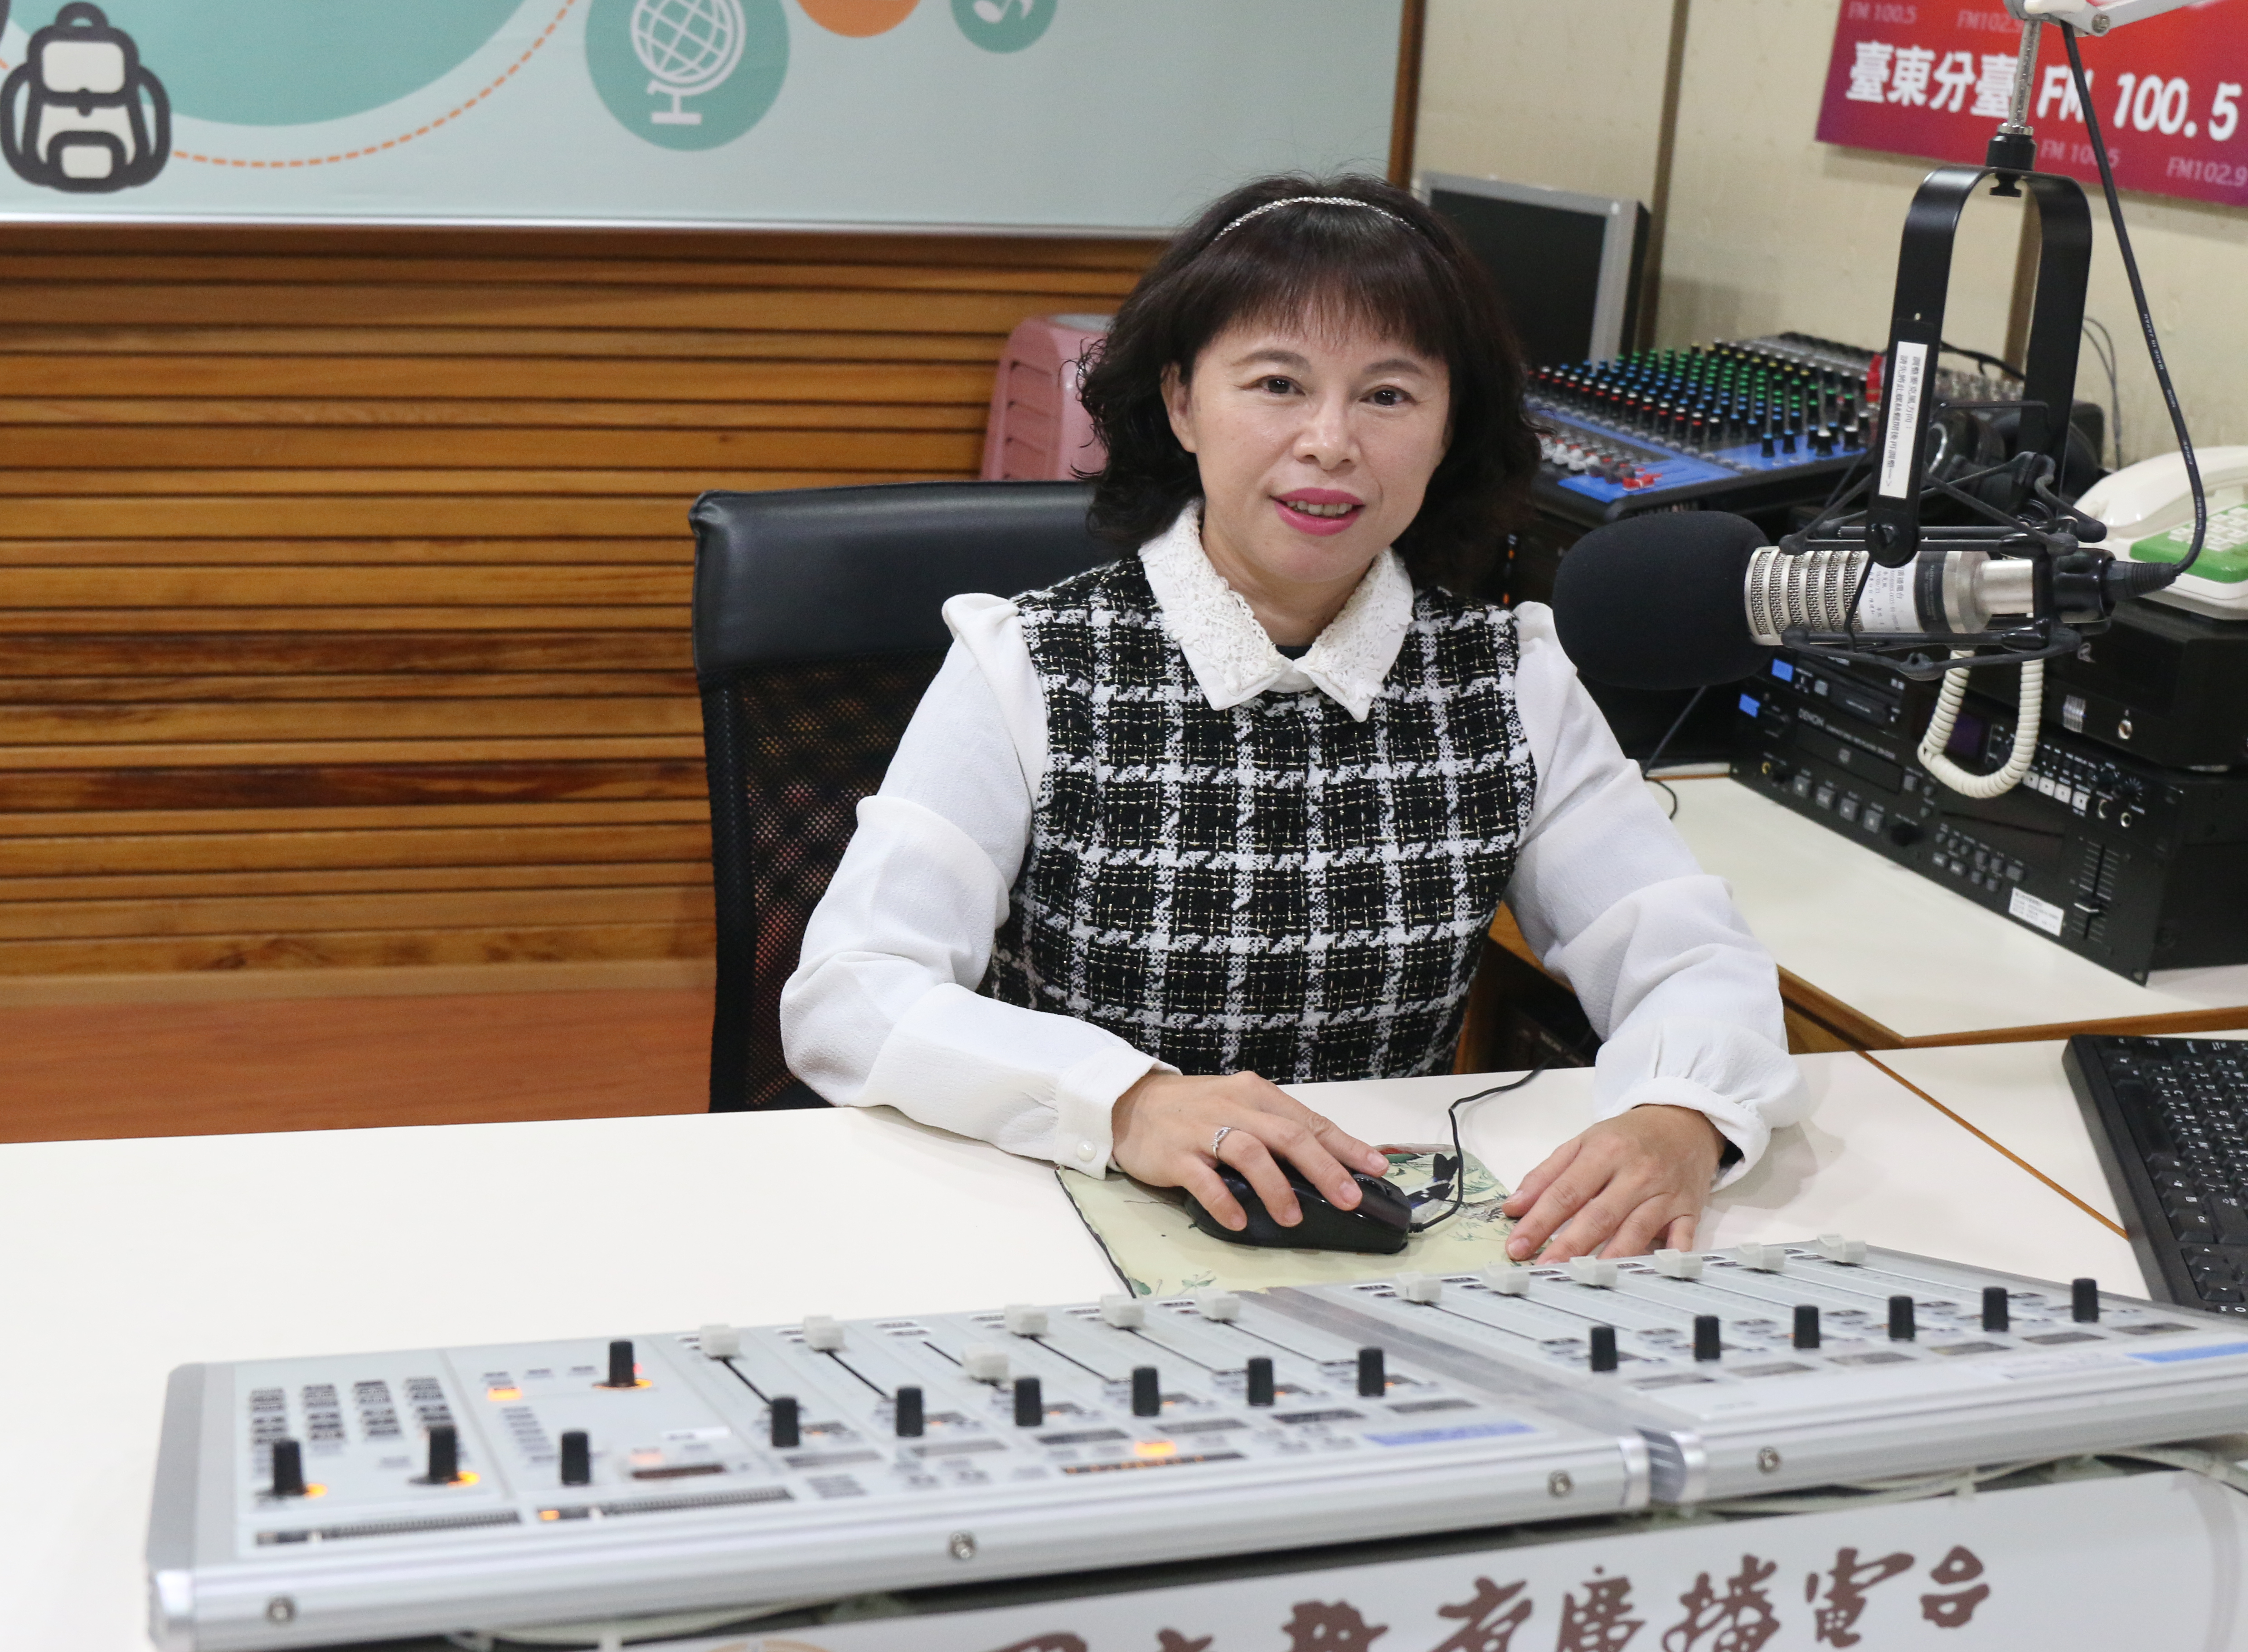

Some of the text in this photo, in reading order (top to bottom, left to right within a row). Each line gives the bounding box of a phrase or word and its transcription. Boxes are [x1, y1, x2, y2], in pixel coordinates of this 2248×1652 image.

[1845, 40, 2243, 141] 臺東分臺 FM 100.5
[2040, 139, 2121, 169] FM 1005
[985, 1545, 1990, 1652] 育廣播電台
